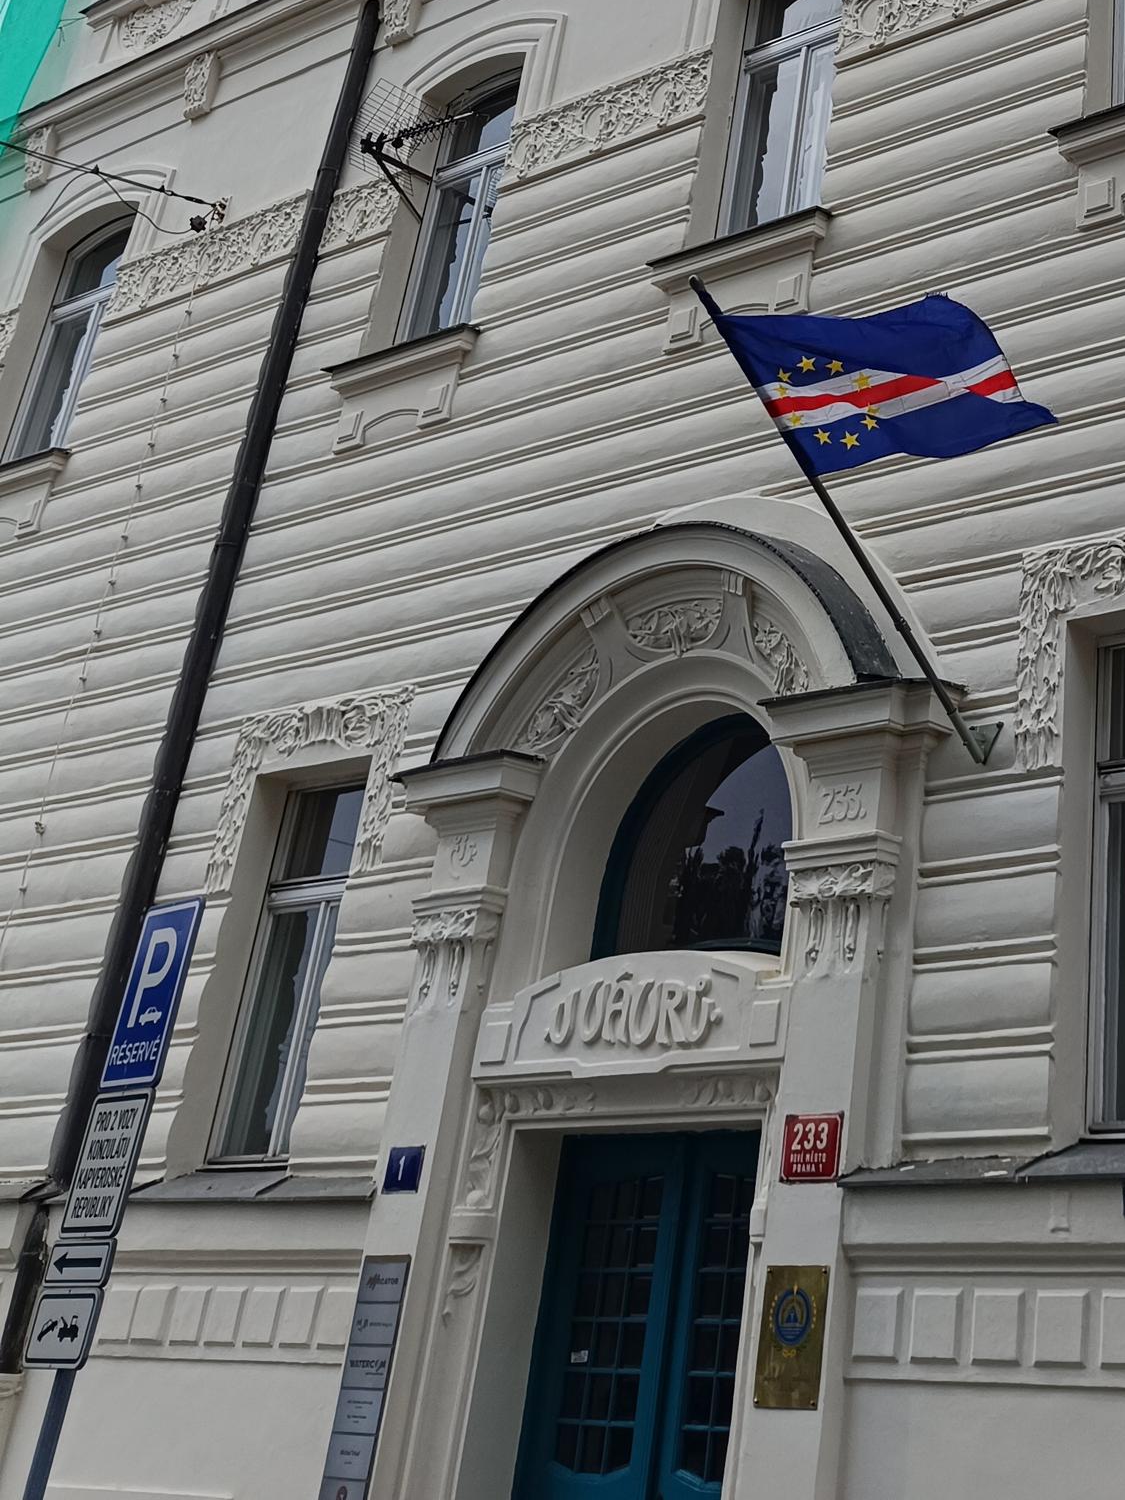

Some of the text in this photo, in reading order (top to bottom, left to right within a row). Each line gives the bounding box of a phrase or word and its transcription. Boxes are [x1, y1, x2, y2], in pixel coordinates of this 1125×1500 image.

[127, 927, 177, 1028] P
[109, 1035, 160, 1066] RÉSERVÉ
[94, 1108, 139, 1132] PRO 2 VOZY
[87, 1132, 131, 1161] KONZULÁTU
[791, 1122, 829, 1150] 233
[76, 1161, 127, 1190] KAPVERDSKÉ
[397, 1155, 406, 1181] 1
[792, 1163, 816, 1173] PRAHA
[71, 1196, 114, 1219] REPUBLIKY
